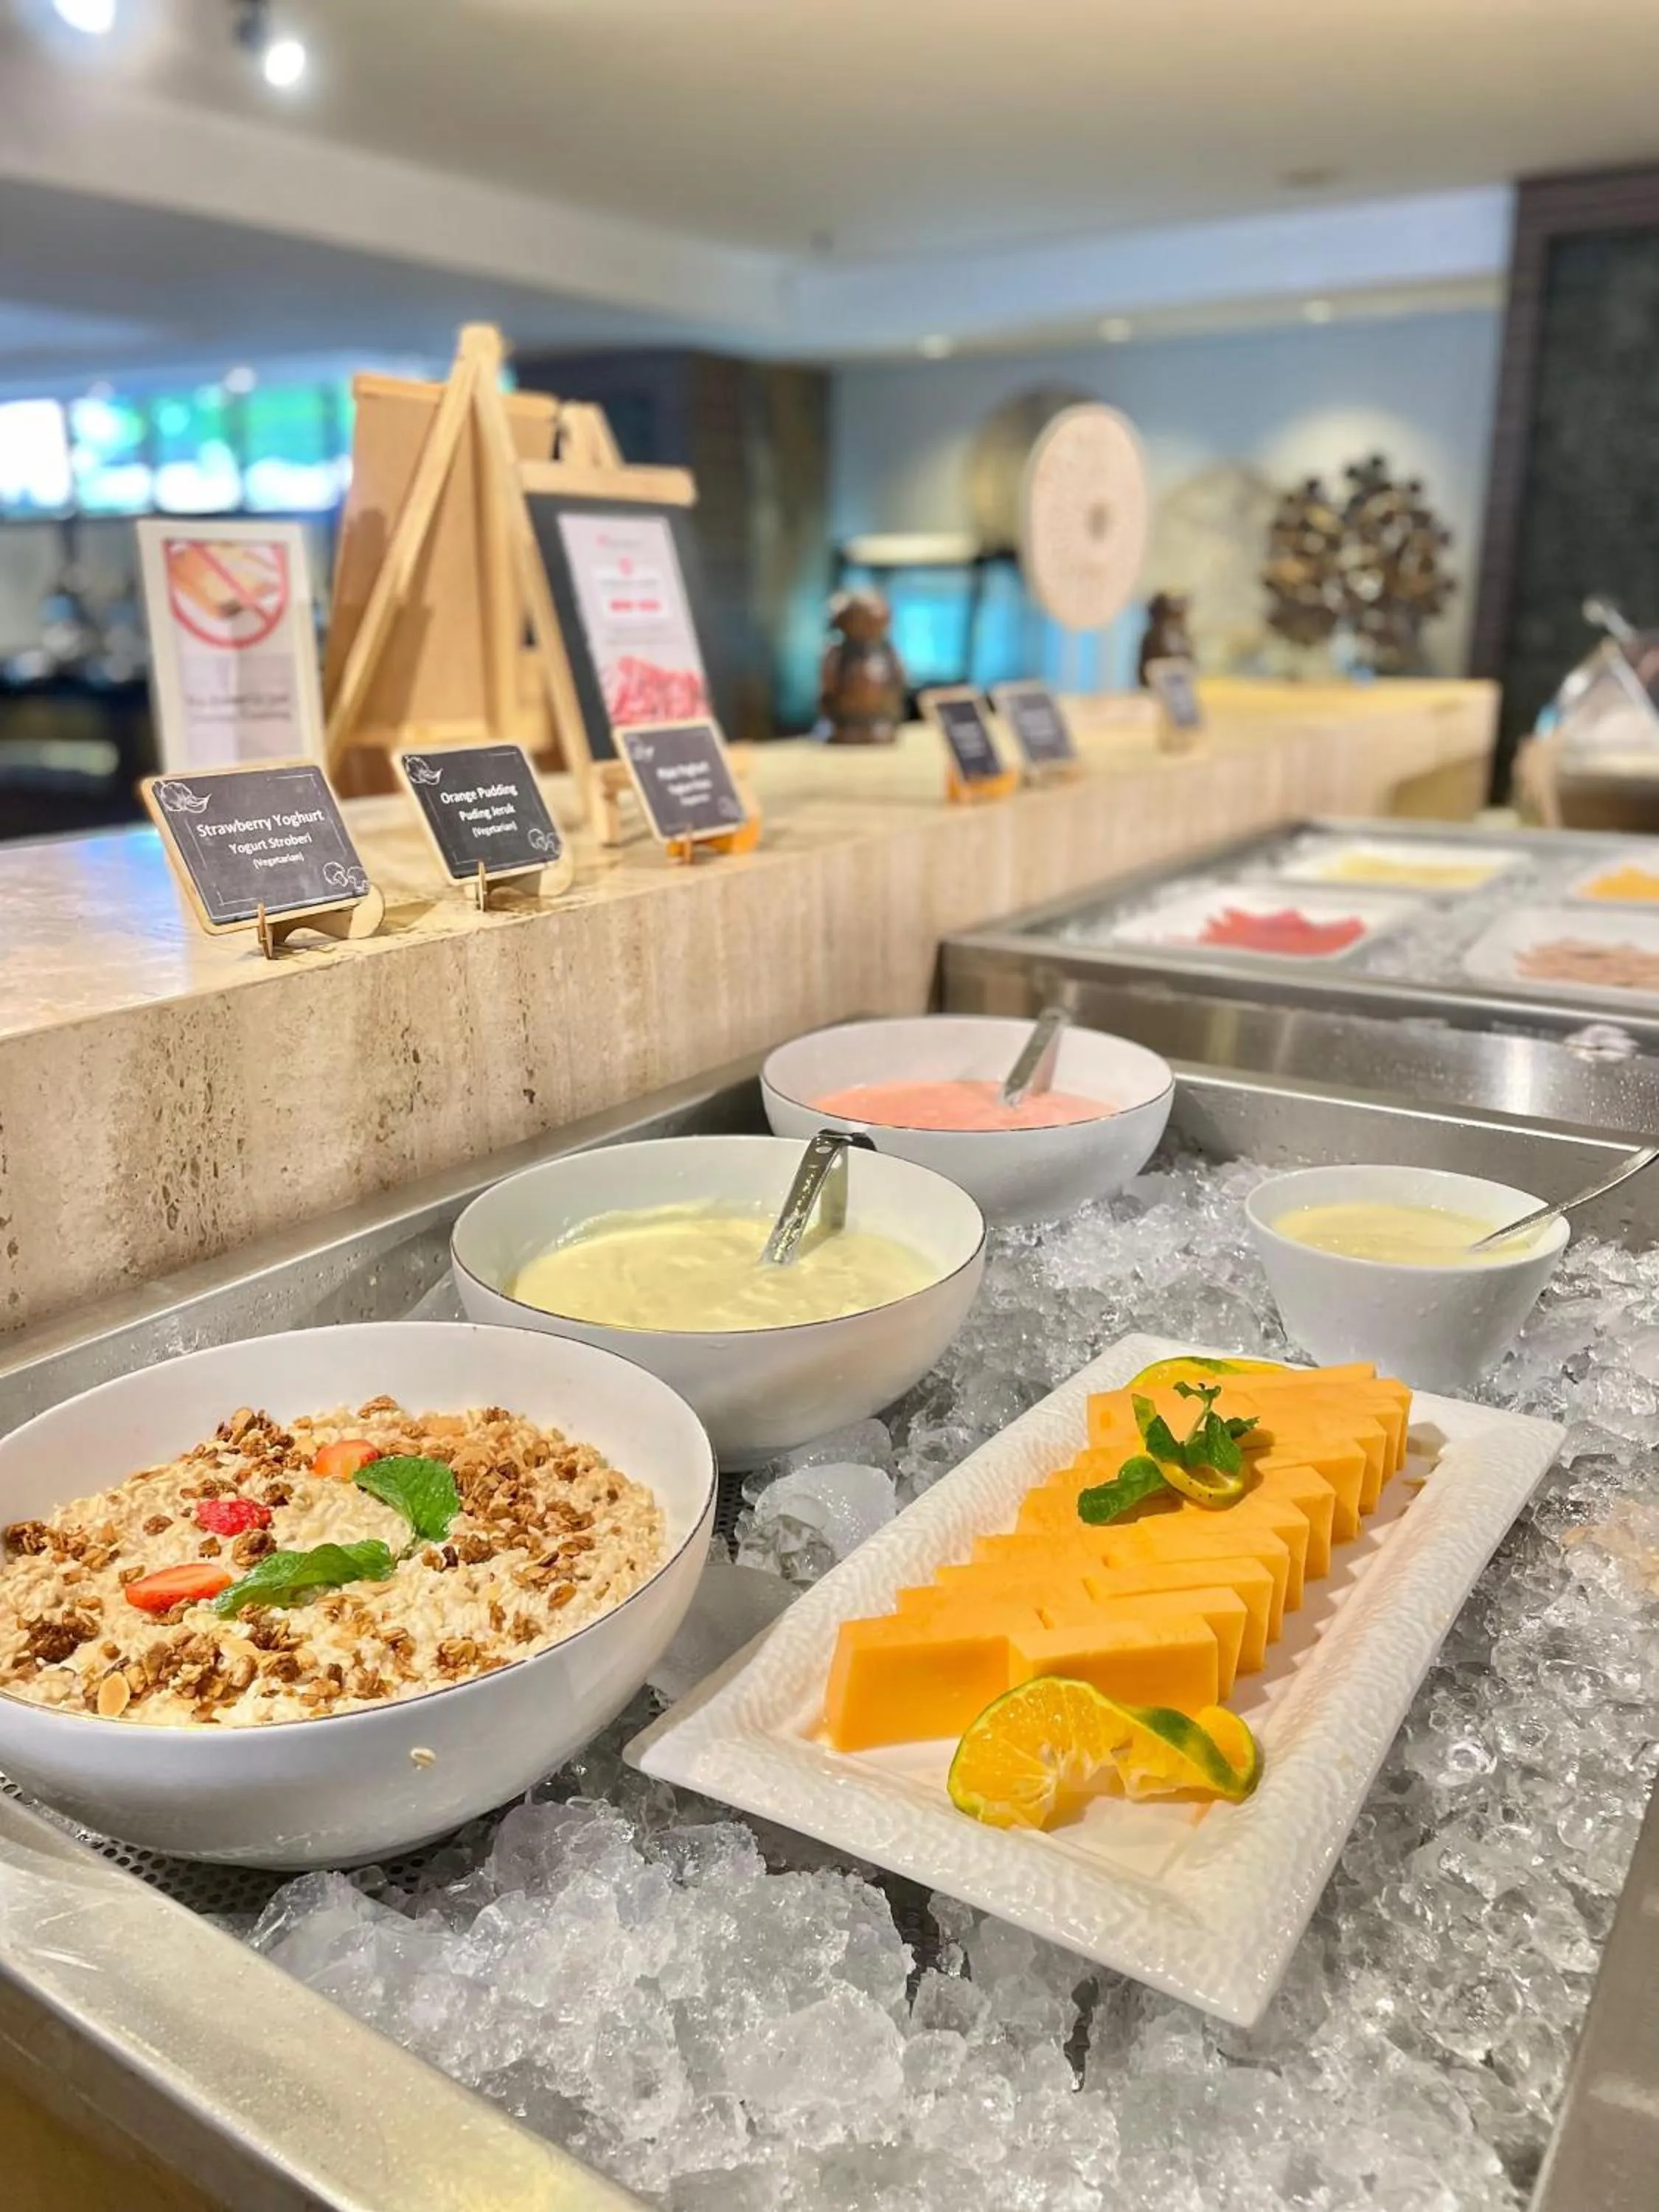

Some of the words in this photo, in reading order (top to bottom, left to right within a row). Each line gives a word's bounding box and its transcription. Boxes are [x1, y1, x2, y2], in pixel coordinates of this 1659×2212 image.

[440, 790, 478, 804] Orange
[476, 784, 518, 799] Pudding
[459, 808, 492, 821] Puding
[491, 803, 516, 816] Jeruk
[196, 819, 272, 838] Strawberry
[273, 810, 324, 827] Yoghurt
[229, 840, 267, 855] Yogurt
[267, 832, 312, 849] Stroberi
